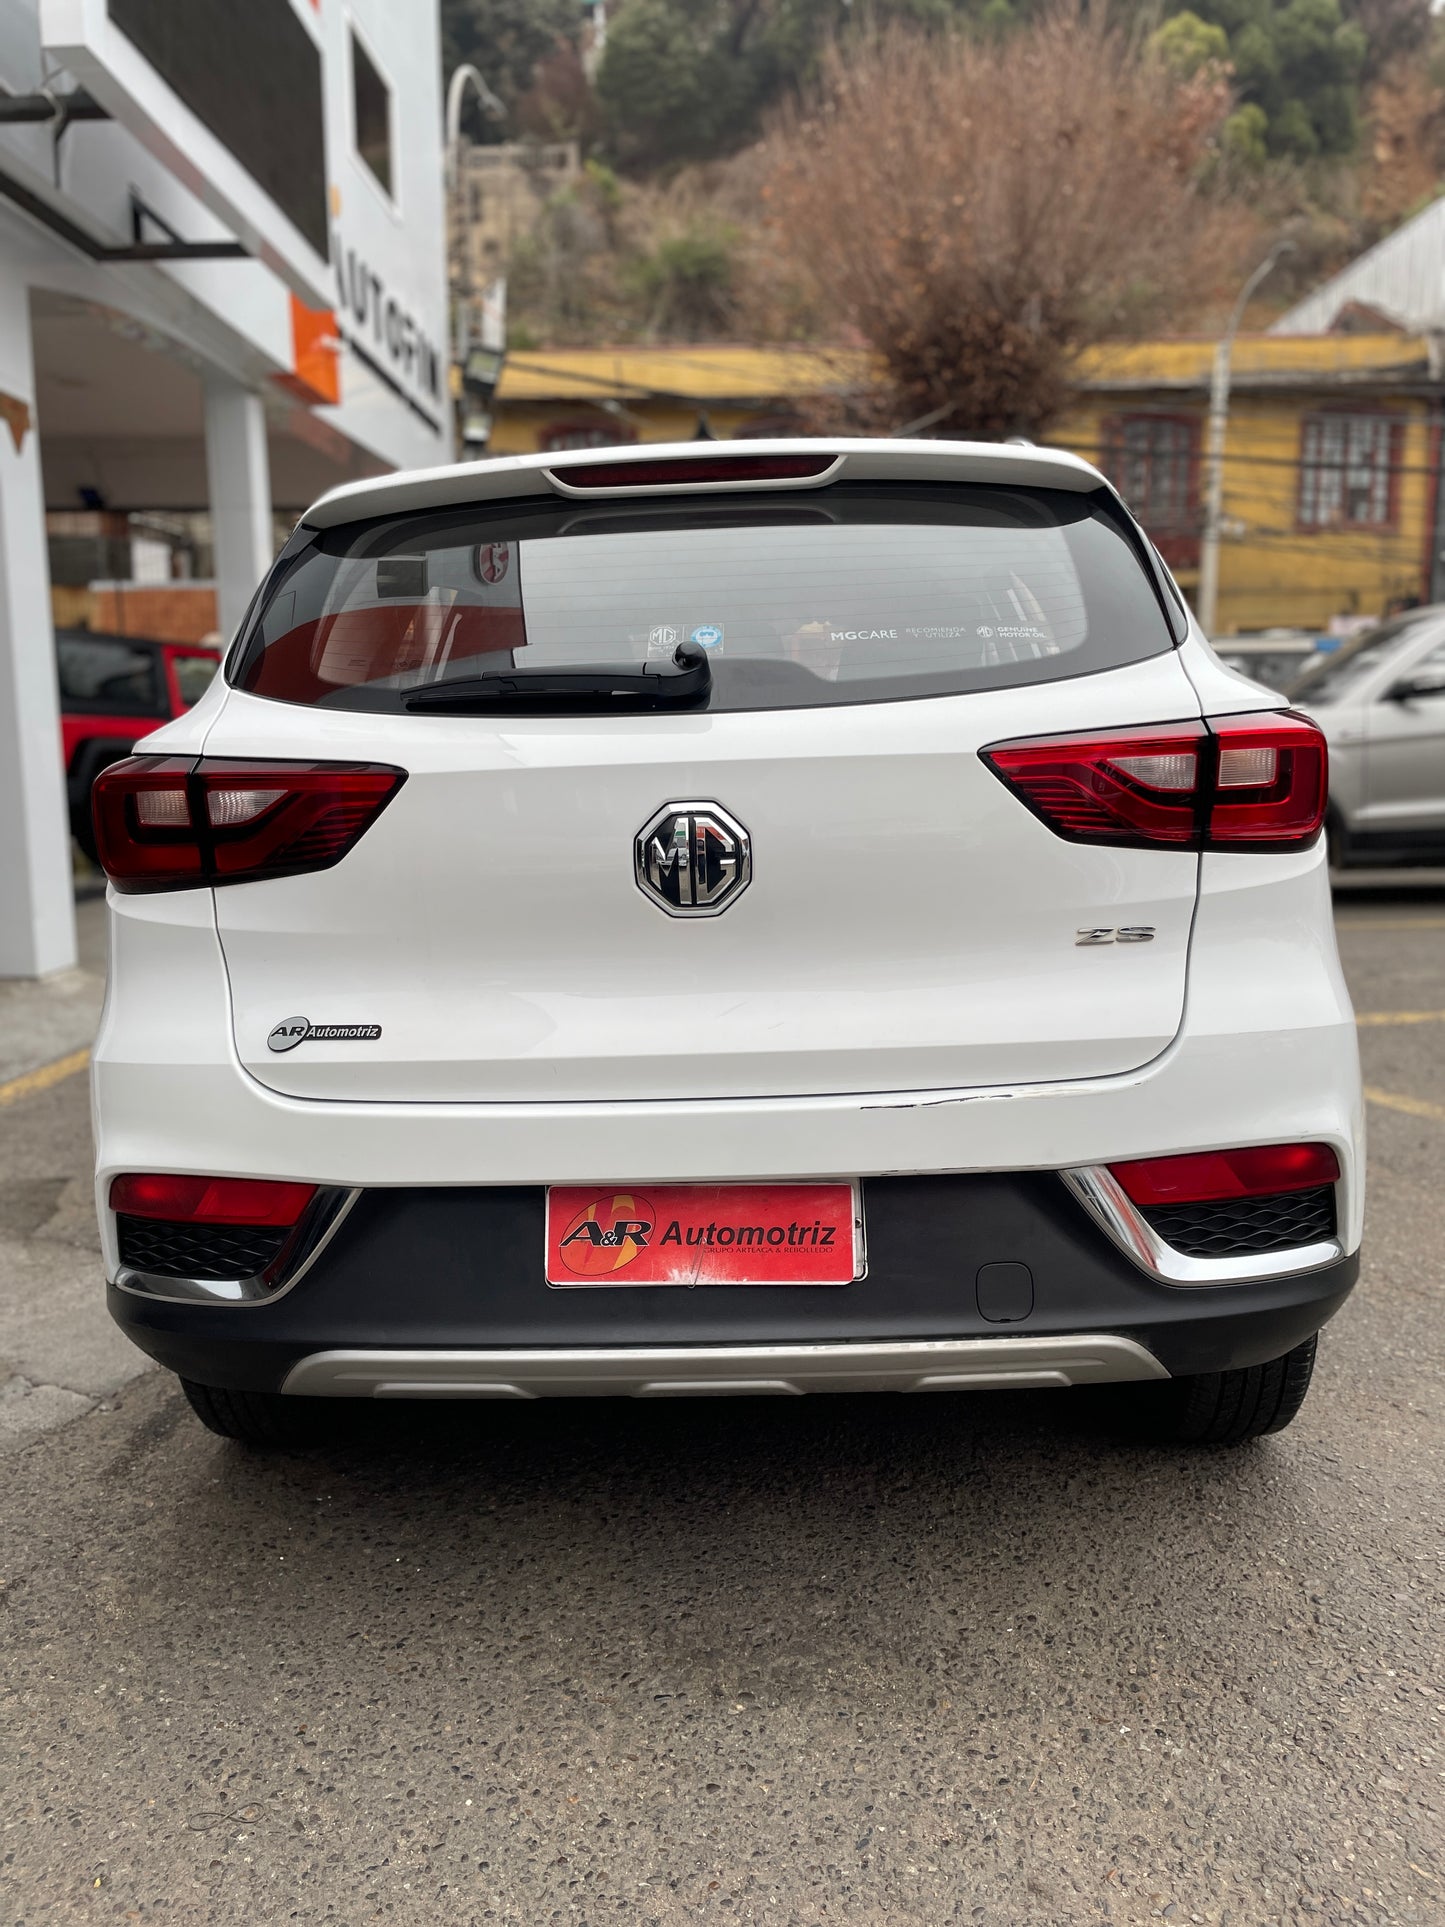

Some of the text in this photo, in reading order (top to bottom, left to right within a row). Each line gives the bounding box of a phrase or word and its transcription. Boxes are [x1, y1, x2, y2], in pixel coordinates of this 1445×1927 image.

[830, 629, 898, 641] MGCARE
[906, 626, 967, 634] RECOMIENDA
[650, 817, 736, 904] MG
[1075, 926, 1156, 946] ZS
[271, 1026, 378, 1037] AR Automotriz
[558, 1220, 836, 1247] A&R Automotriz
